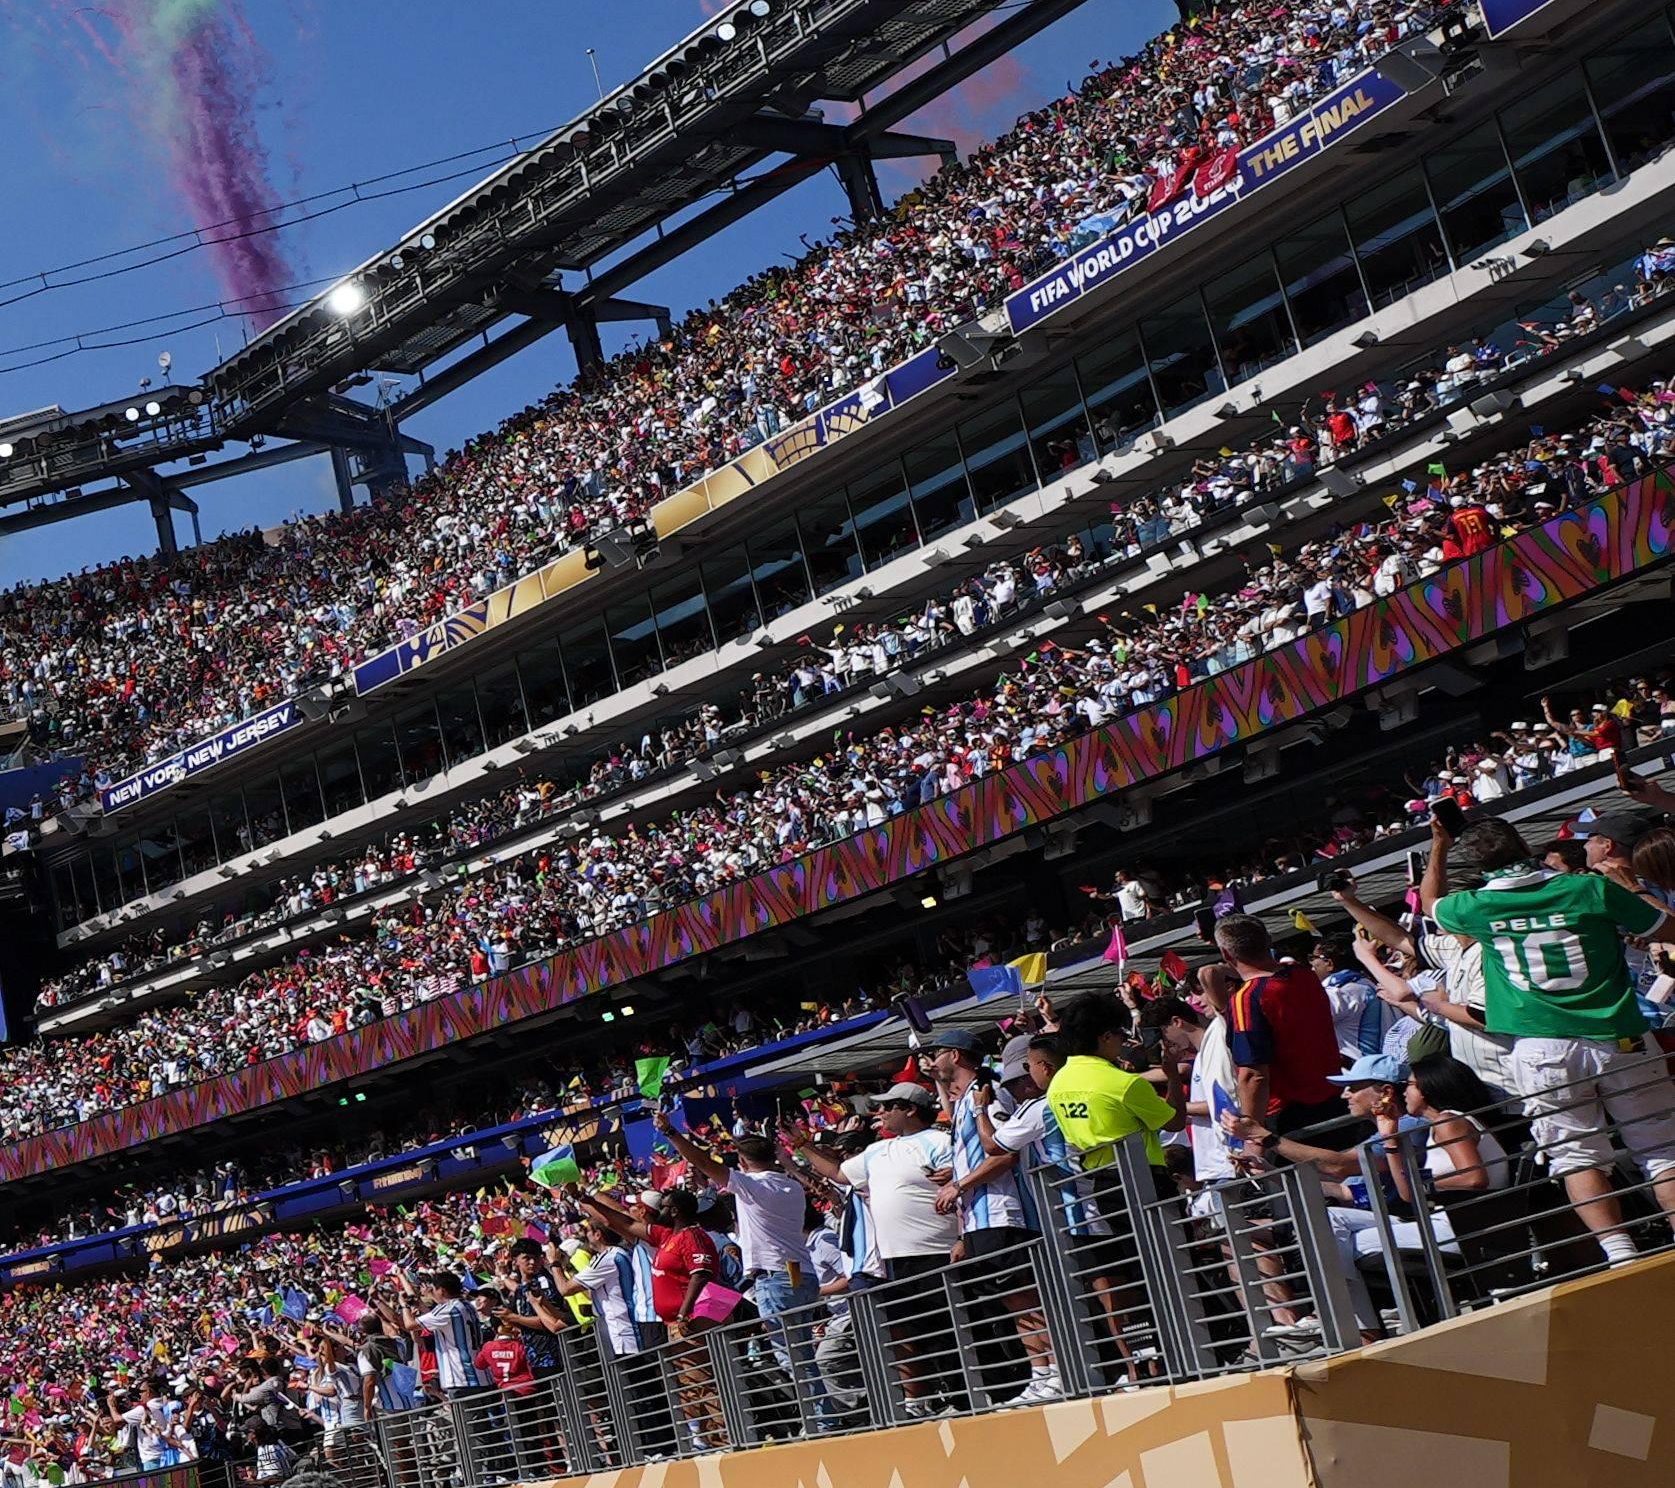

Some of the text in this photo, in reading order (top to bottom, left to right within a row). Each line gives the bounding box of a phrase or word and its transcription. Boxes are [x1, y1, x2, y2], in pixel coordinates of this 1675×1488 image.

[1031, 278, 1070, 312] FIFA
[1074, 240, 1134, 290] WORLD
[1135, 218, 1172, 254] CUP
[1247, 145, 1300, 182] THE
[1303, 89, 1374, 156] FINAL
[110, 709, 290, 806] NEW YOR NEW JERSEY
[1489, 913, 1566, 931] PELE
[1492, 930, 1589, 992] 10
